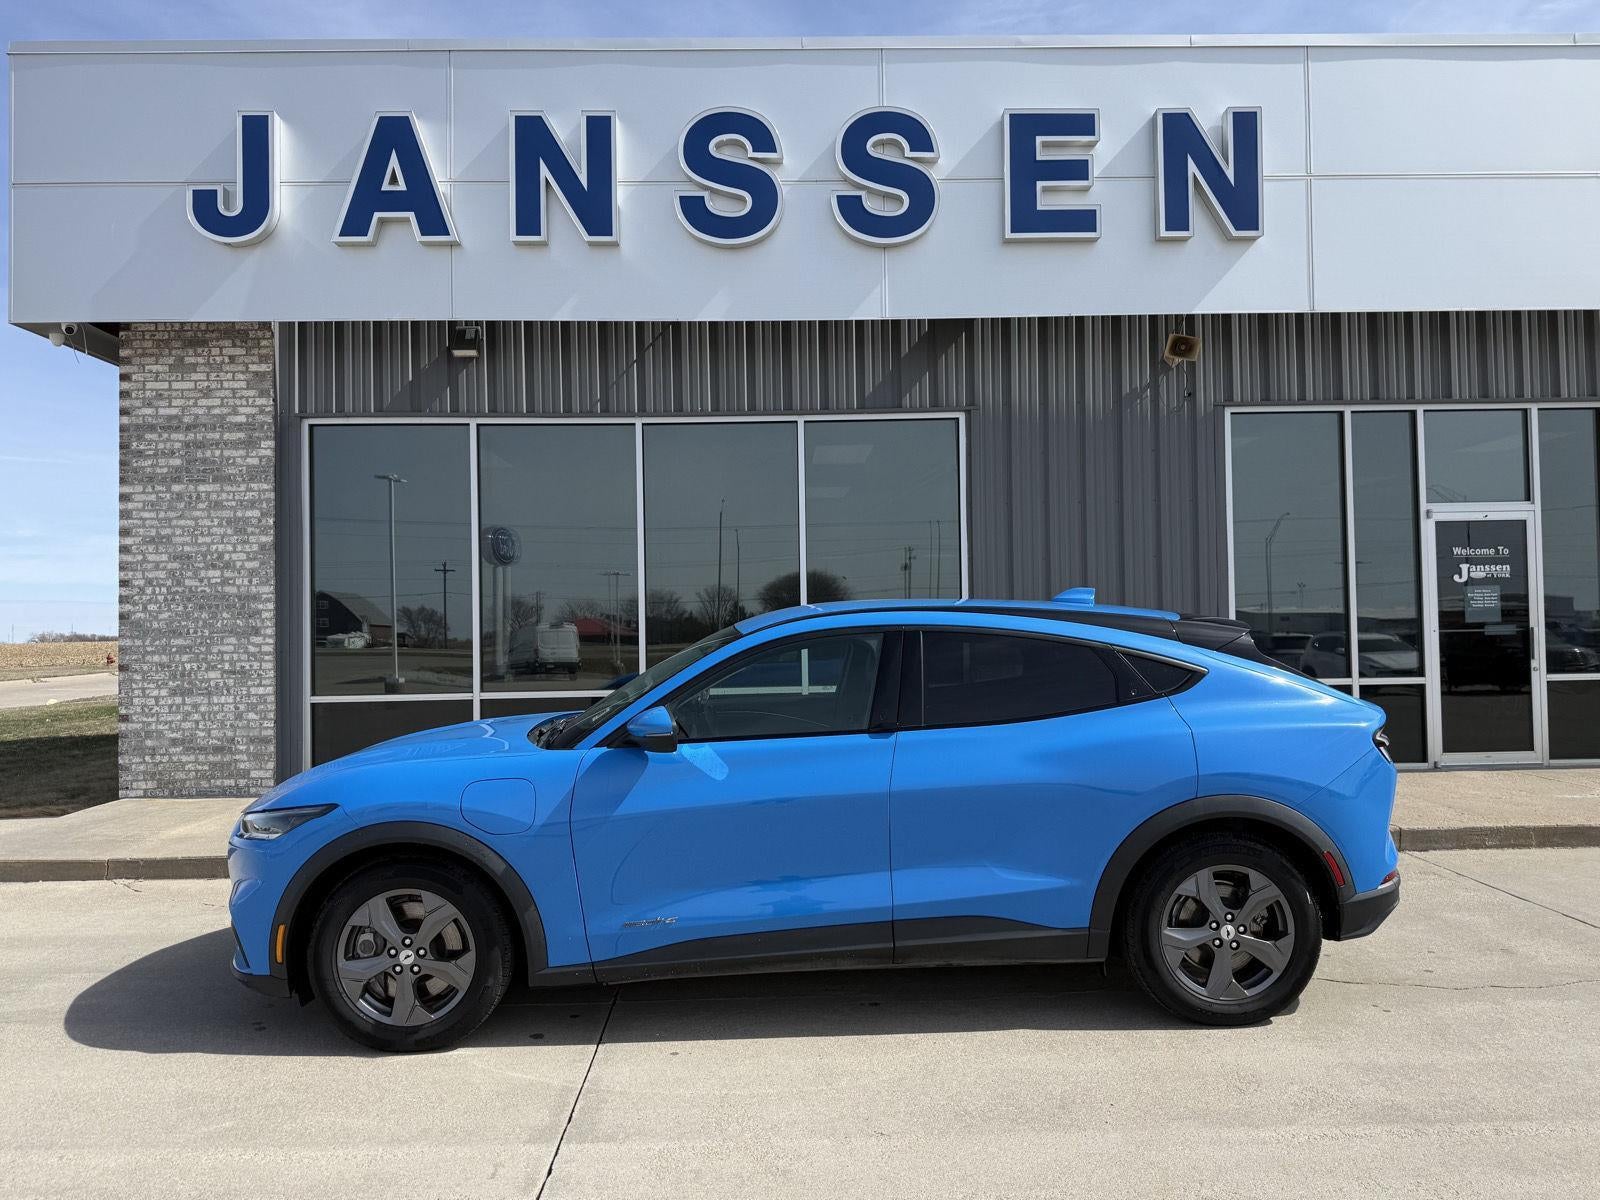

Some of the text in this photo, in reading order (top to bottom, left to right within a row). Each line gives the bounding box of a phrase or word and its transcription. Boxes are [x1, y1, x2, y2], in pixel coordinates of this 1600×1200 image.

[186, 107, 1265, 246] JANSSEN
[1452, 546, 1508, 555] Welcome To
[1453, 563, 1510, 582] Janssen
